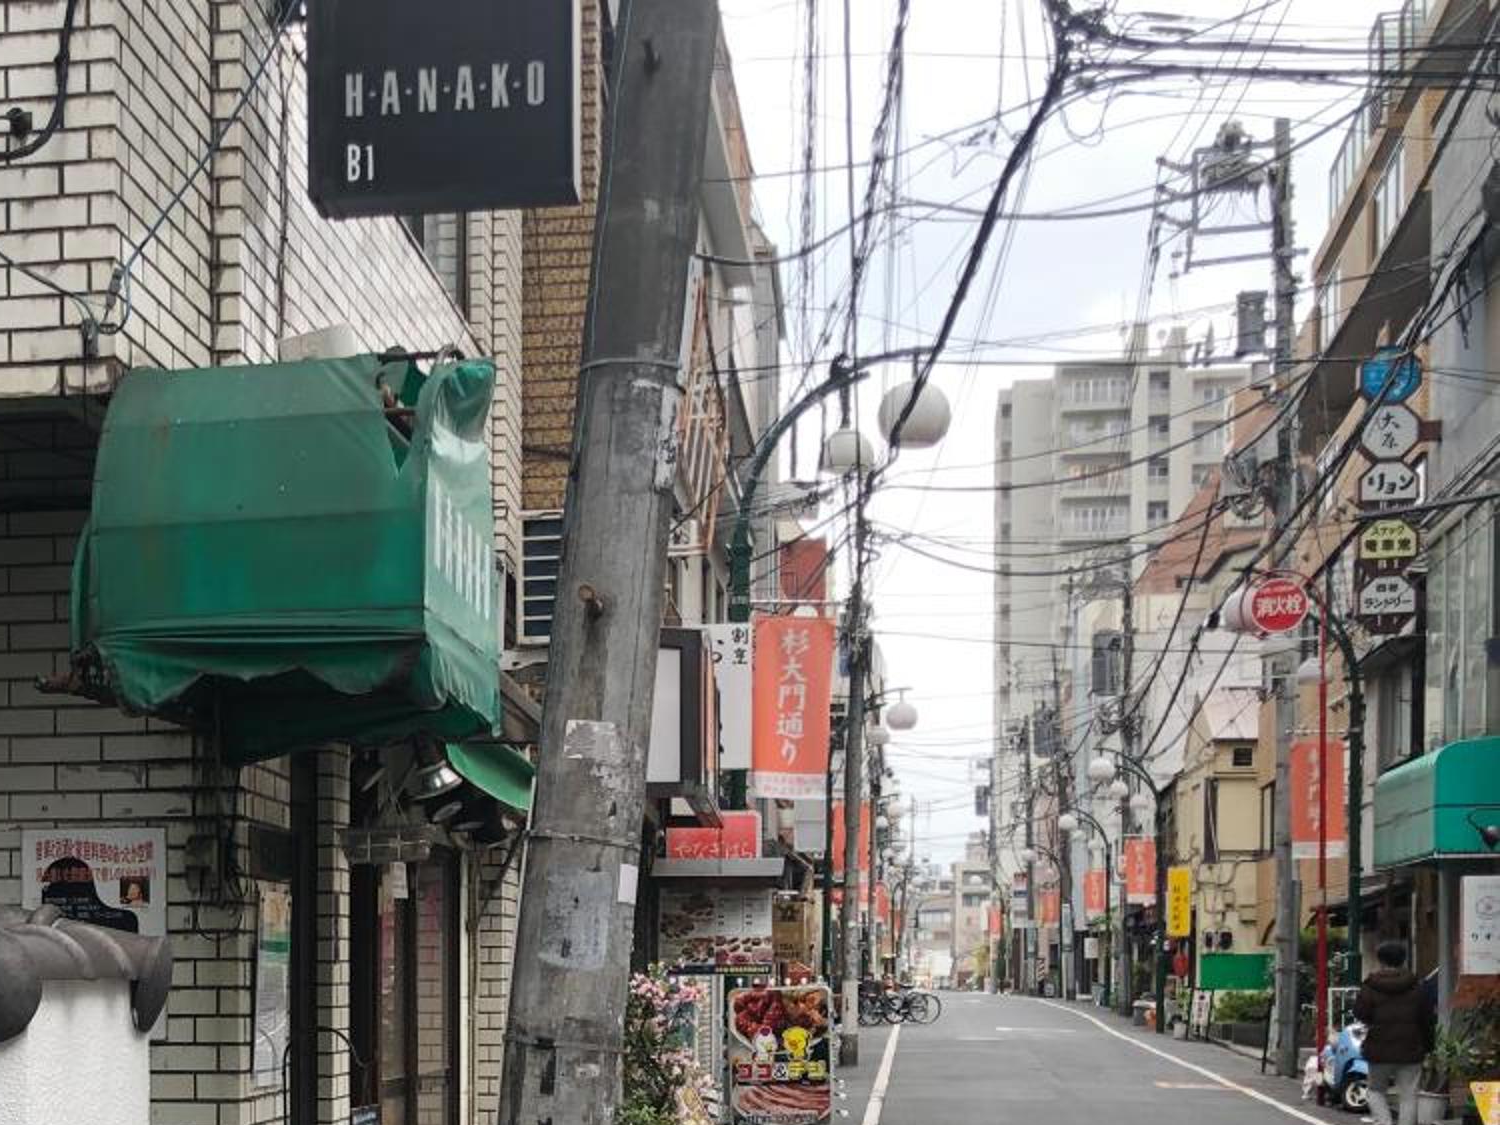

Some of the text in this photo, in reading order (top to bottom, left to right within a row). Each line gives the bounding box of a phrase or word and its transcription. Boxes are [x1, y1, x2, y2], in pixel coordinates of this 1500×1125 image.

[347, 143, 375, 183] B1
[1257, 593, 1303, 619] 消火栓
[775, 627, 811, 767] 杉大門通り
